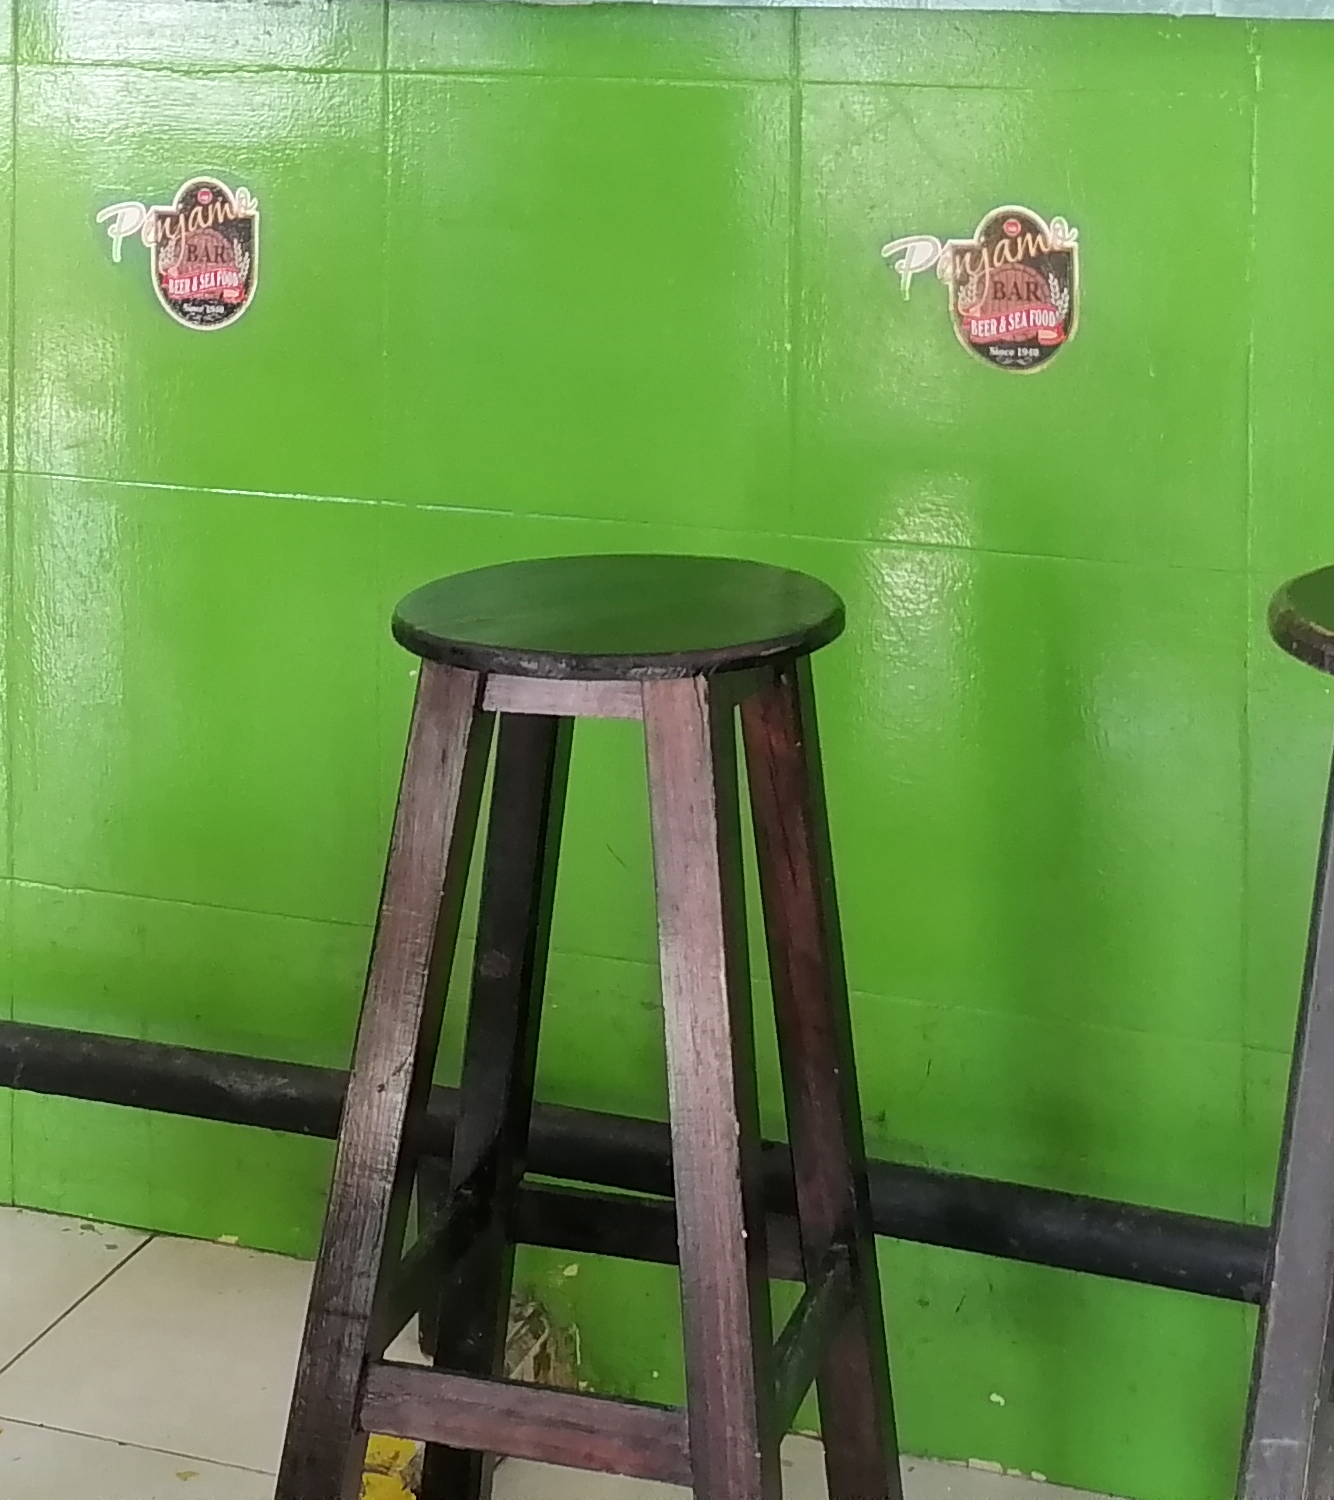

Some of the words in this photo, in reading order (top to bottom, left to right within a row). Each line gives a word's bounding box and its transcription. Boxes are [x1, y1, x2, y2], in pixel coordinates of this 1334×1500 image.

[186, 243, 226, 264] BAR
[169, 277, 191, 295] BEER
[191, 275, 198, 292] &
[200, 273, 216, 289] SEA
[217, 271, 239, 288] FOOD
[993, 280, 1041, 301] BAR
[971, 318, 997, 338] BEER
[999, 316, 1007, 333] &
[1008, 312, 1028, 330] SEA
[1030, 309, 1056, 328] FOOD
